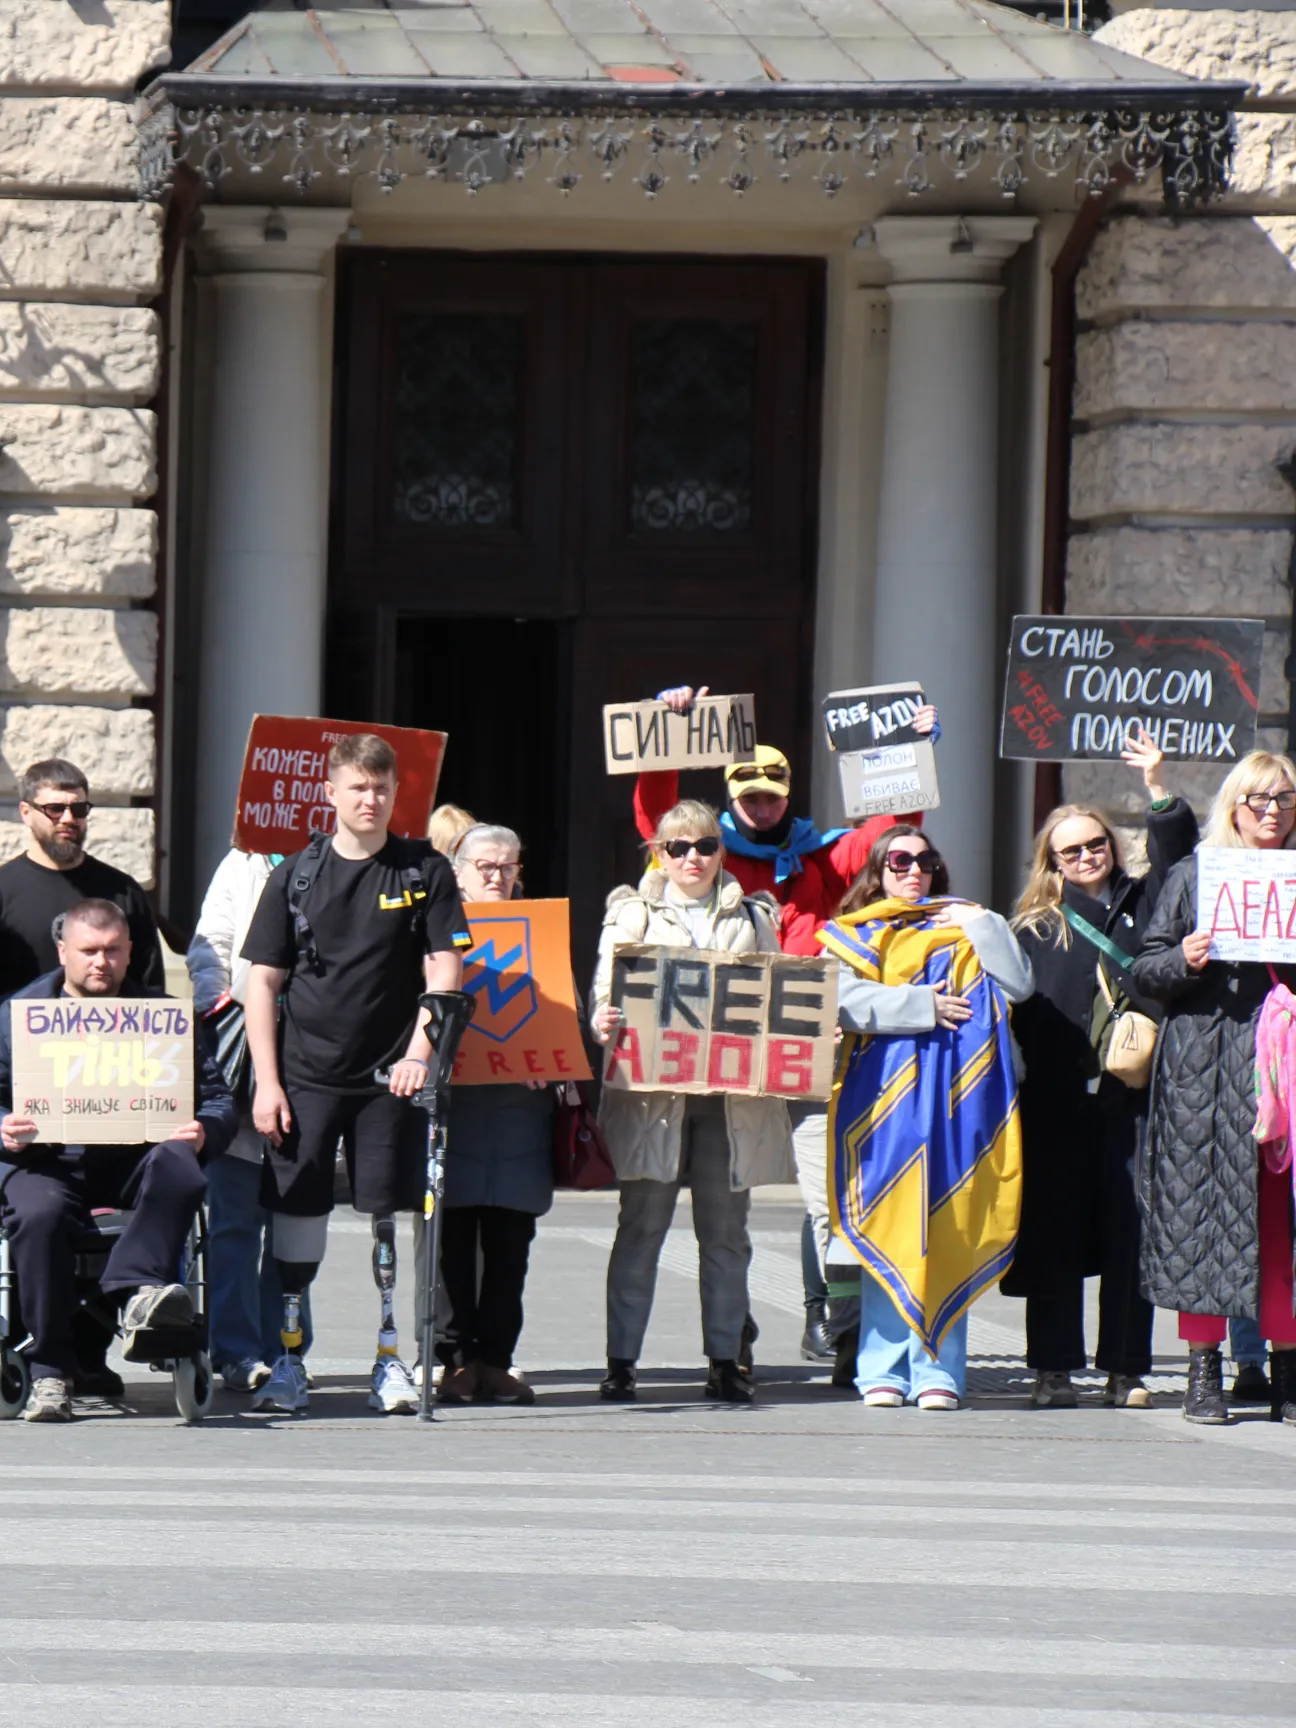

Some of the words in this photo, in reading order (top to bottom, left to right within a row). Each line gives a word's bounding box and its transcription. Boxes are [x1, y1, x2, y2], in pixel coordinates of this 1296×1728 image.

[1020, 626, 1115, 660] СТАНЬ
[1065, 664, 1213, 708] ГОЛОСОМ
[610, 703, 755, 761] СИГНАЛЬ
[826, 701, 870, 736] FREE
[870, 695, 924, 740] AZOV
[1071, 712, 1236, 757] ПОЛОНЕНИХ
[252, 746, 325, 778] КОЖЕН
[862, 752, 913, 770] ПОЛОН
[273, 781, 285, 801] В
[291, 781, 328, 803] ПОЛ
[864, 779, 920, 798] ВБИВАЄ
[900, 791, 936, 809] AZOV
[244, 801, 303, 831] МОЖЕ
[610, 955, 827, 1038] FREE
[26, 1002, 189, 1036] БАЙДУЖІСТЬ
[605, 1027, 815, 1094] АЗОВ
[24, 1098, 51, 1116] ЯКА
[62, 1097, 121, 1115] ЗНИЩУЄ
[130, 1094, 180, 1112] СВІТЛО
